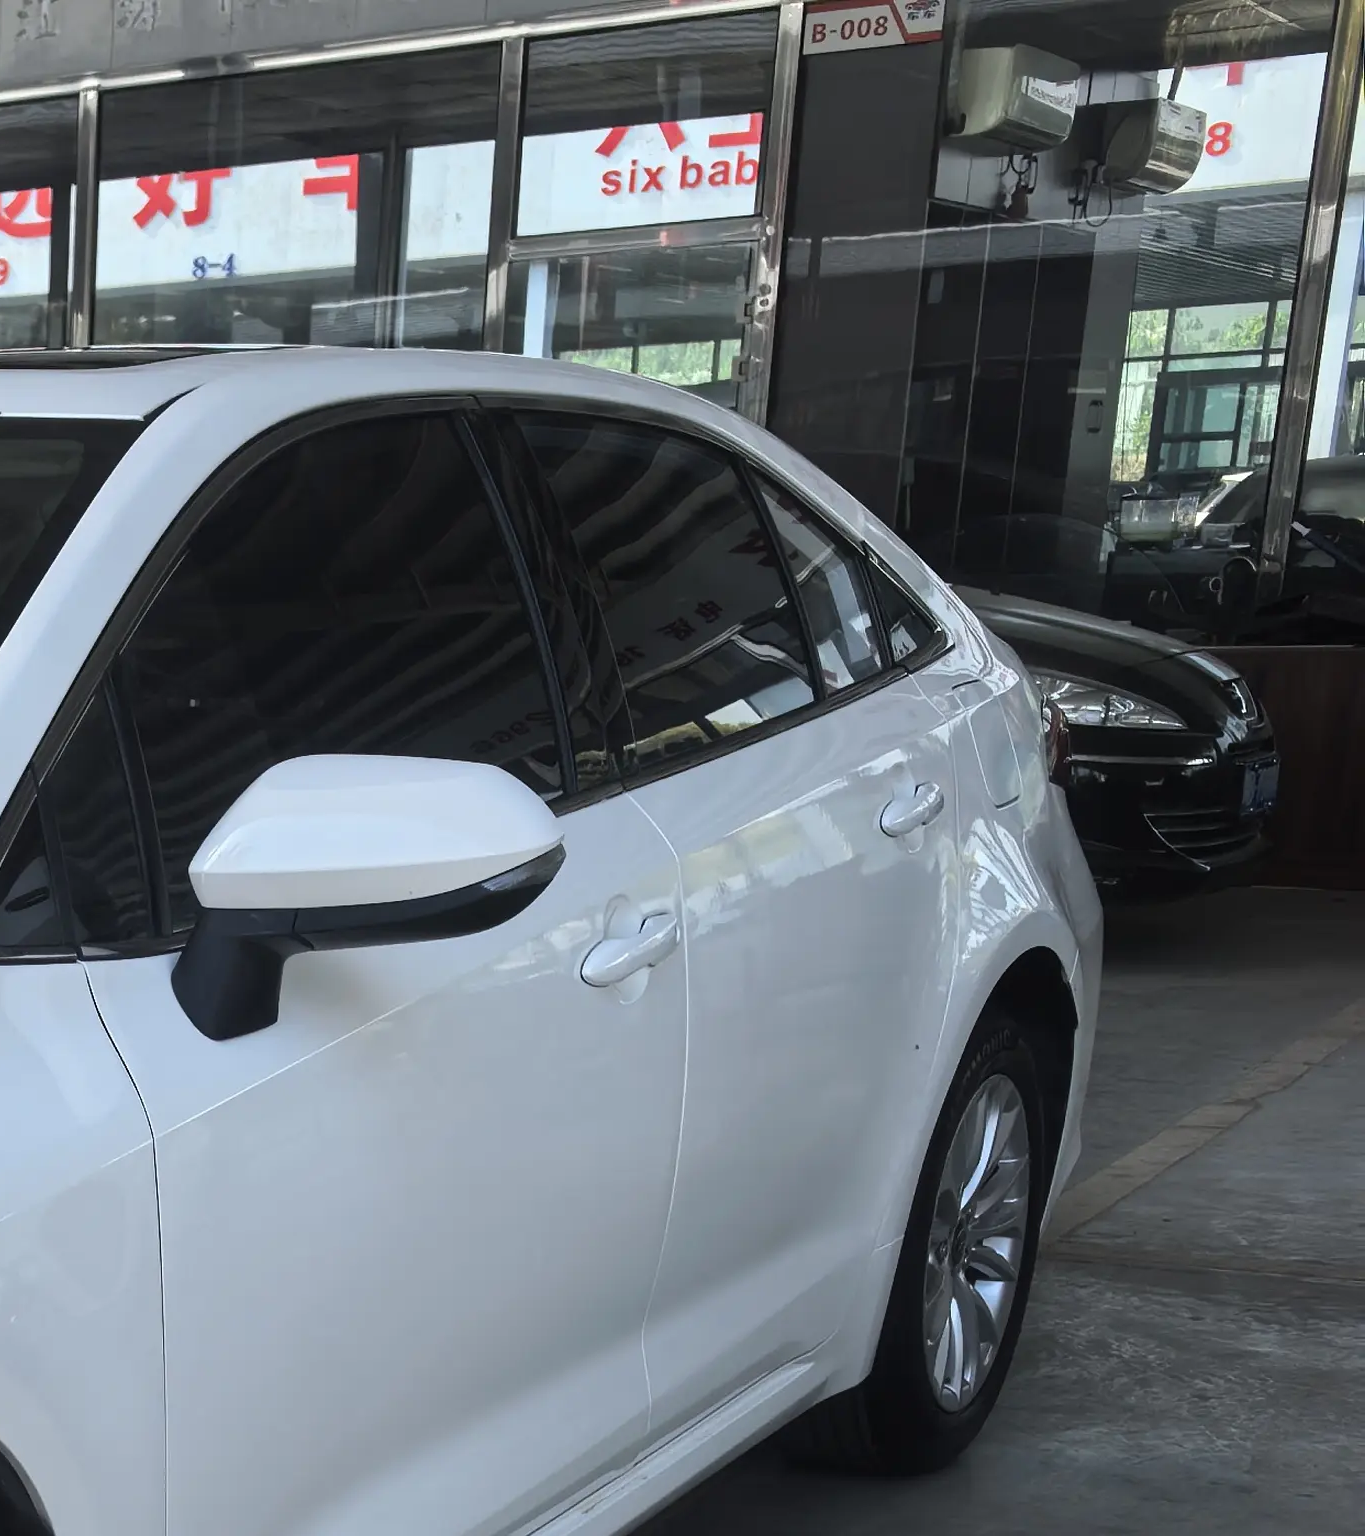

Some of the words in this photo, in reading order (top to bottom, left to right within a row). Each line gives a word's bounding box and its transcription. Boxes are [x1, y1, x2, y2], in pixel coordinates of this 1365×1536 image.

[811, 16, 889, 43] B-008
[600, 159, 666, 196] six
[192, 252, 236, 280] 8-4
